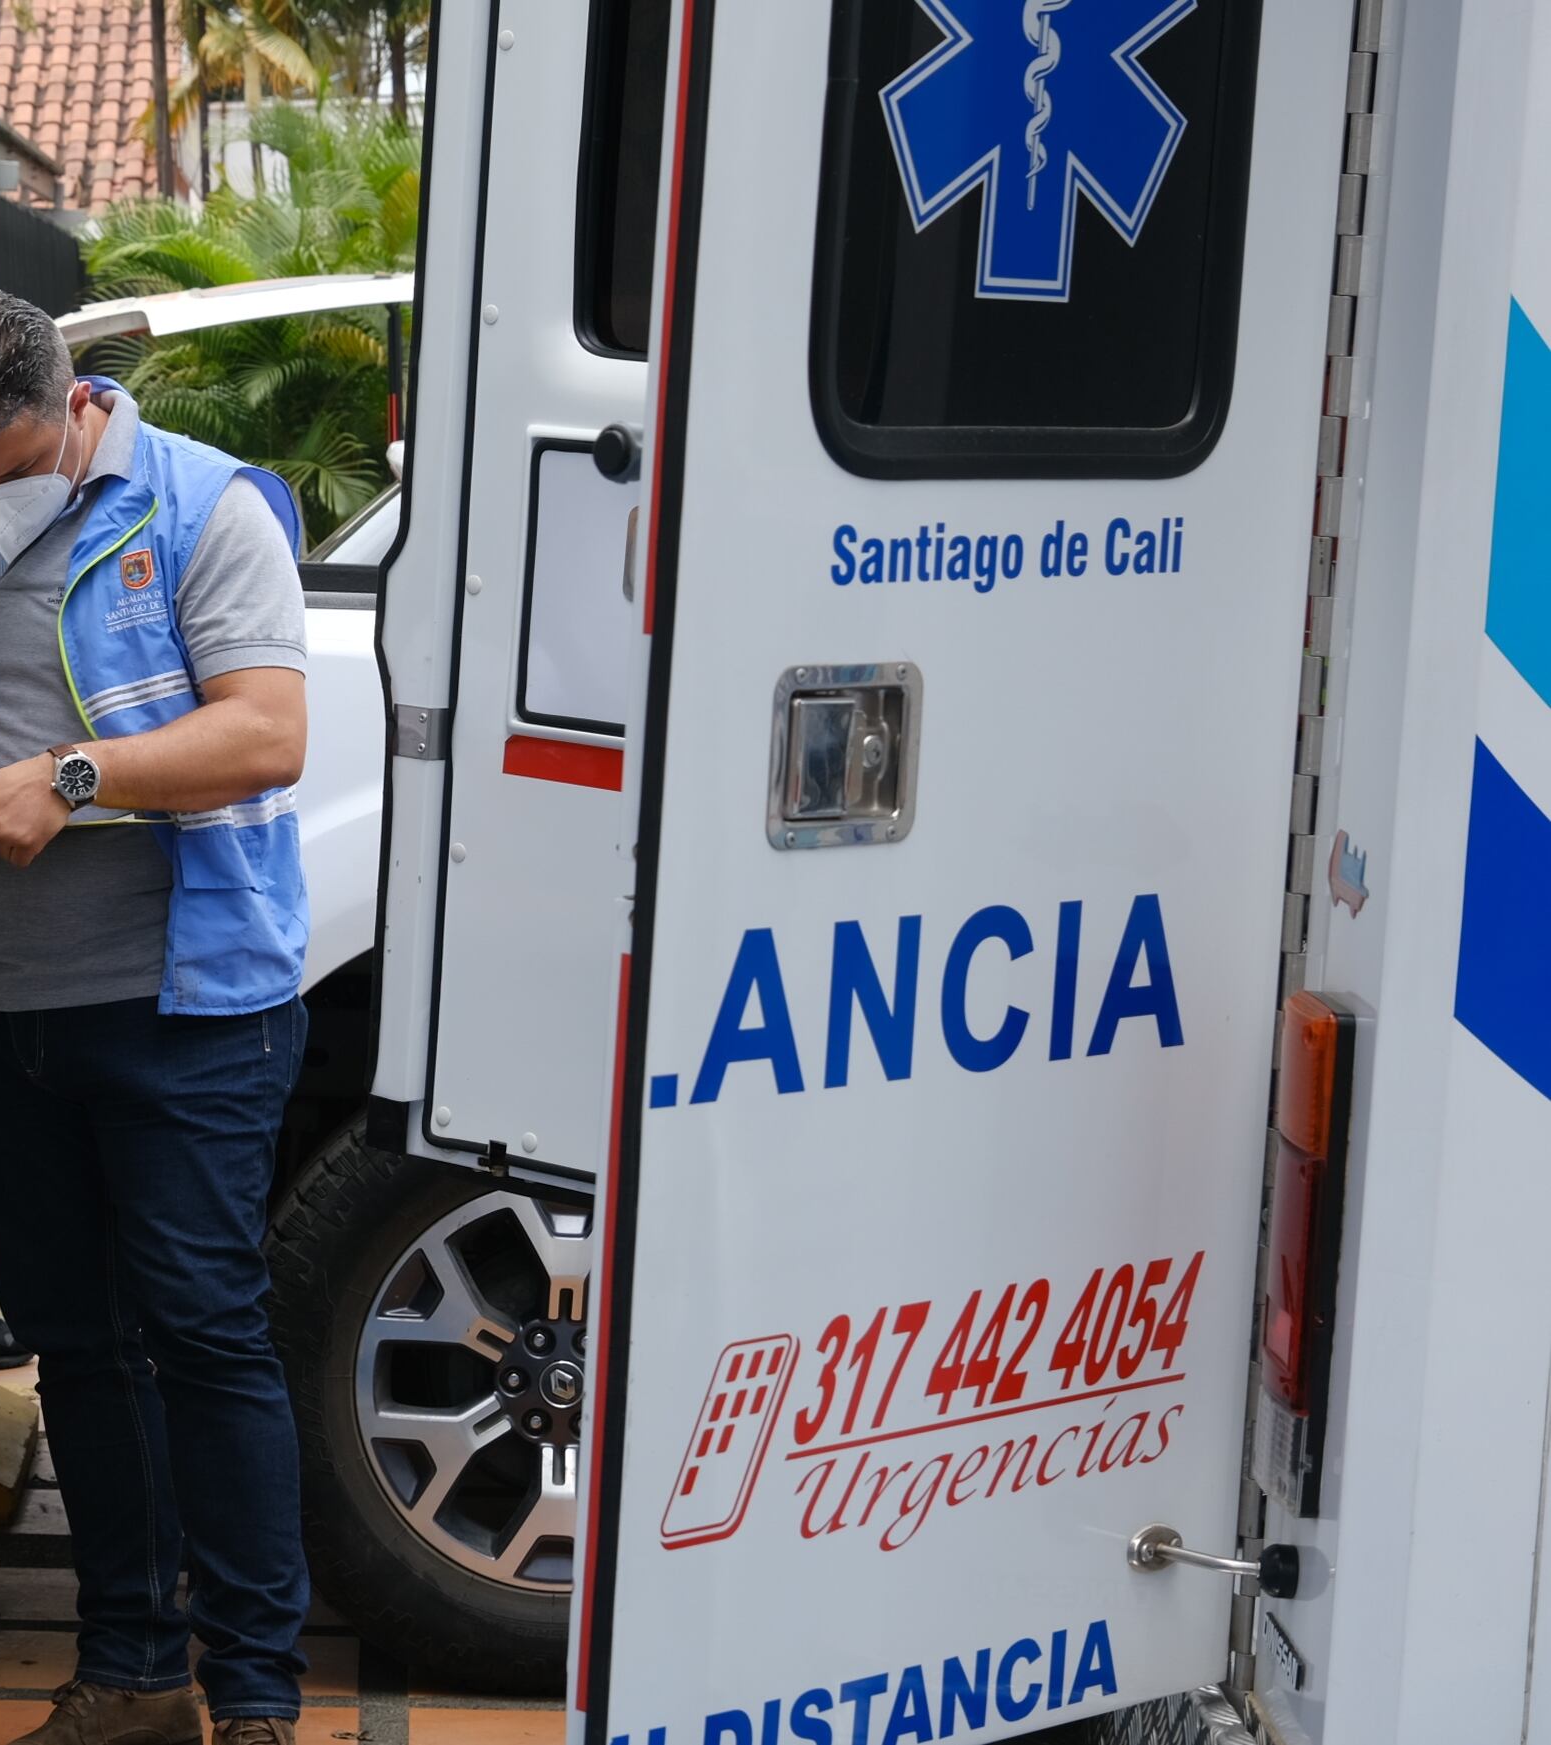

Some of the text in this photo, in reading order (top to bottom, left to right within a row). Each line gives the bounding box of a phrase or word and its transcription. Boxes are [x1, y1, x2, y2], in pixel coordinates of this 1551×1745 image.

[830, 516, 1184, 593] Santiago de Cali
[793, 1250, 1206, 1446] 317 442 4054
[794, 1395, 1185, 1552] Urgencías
